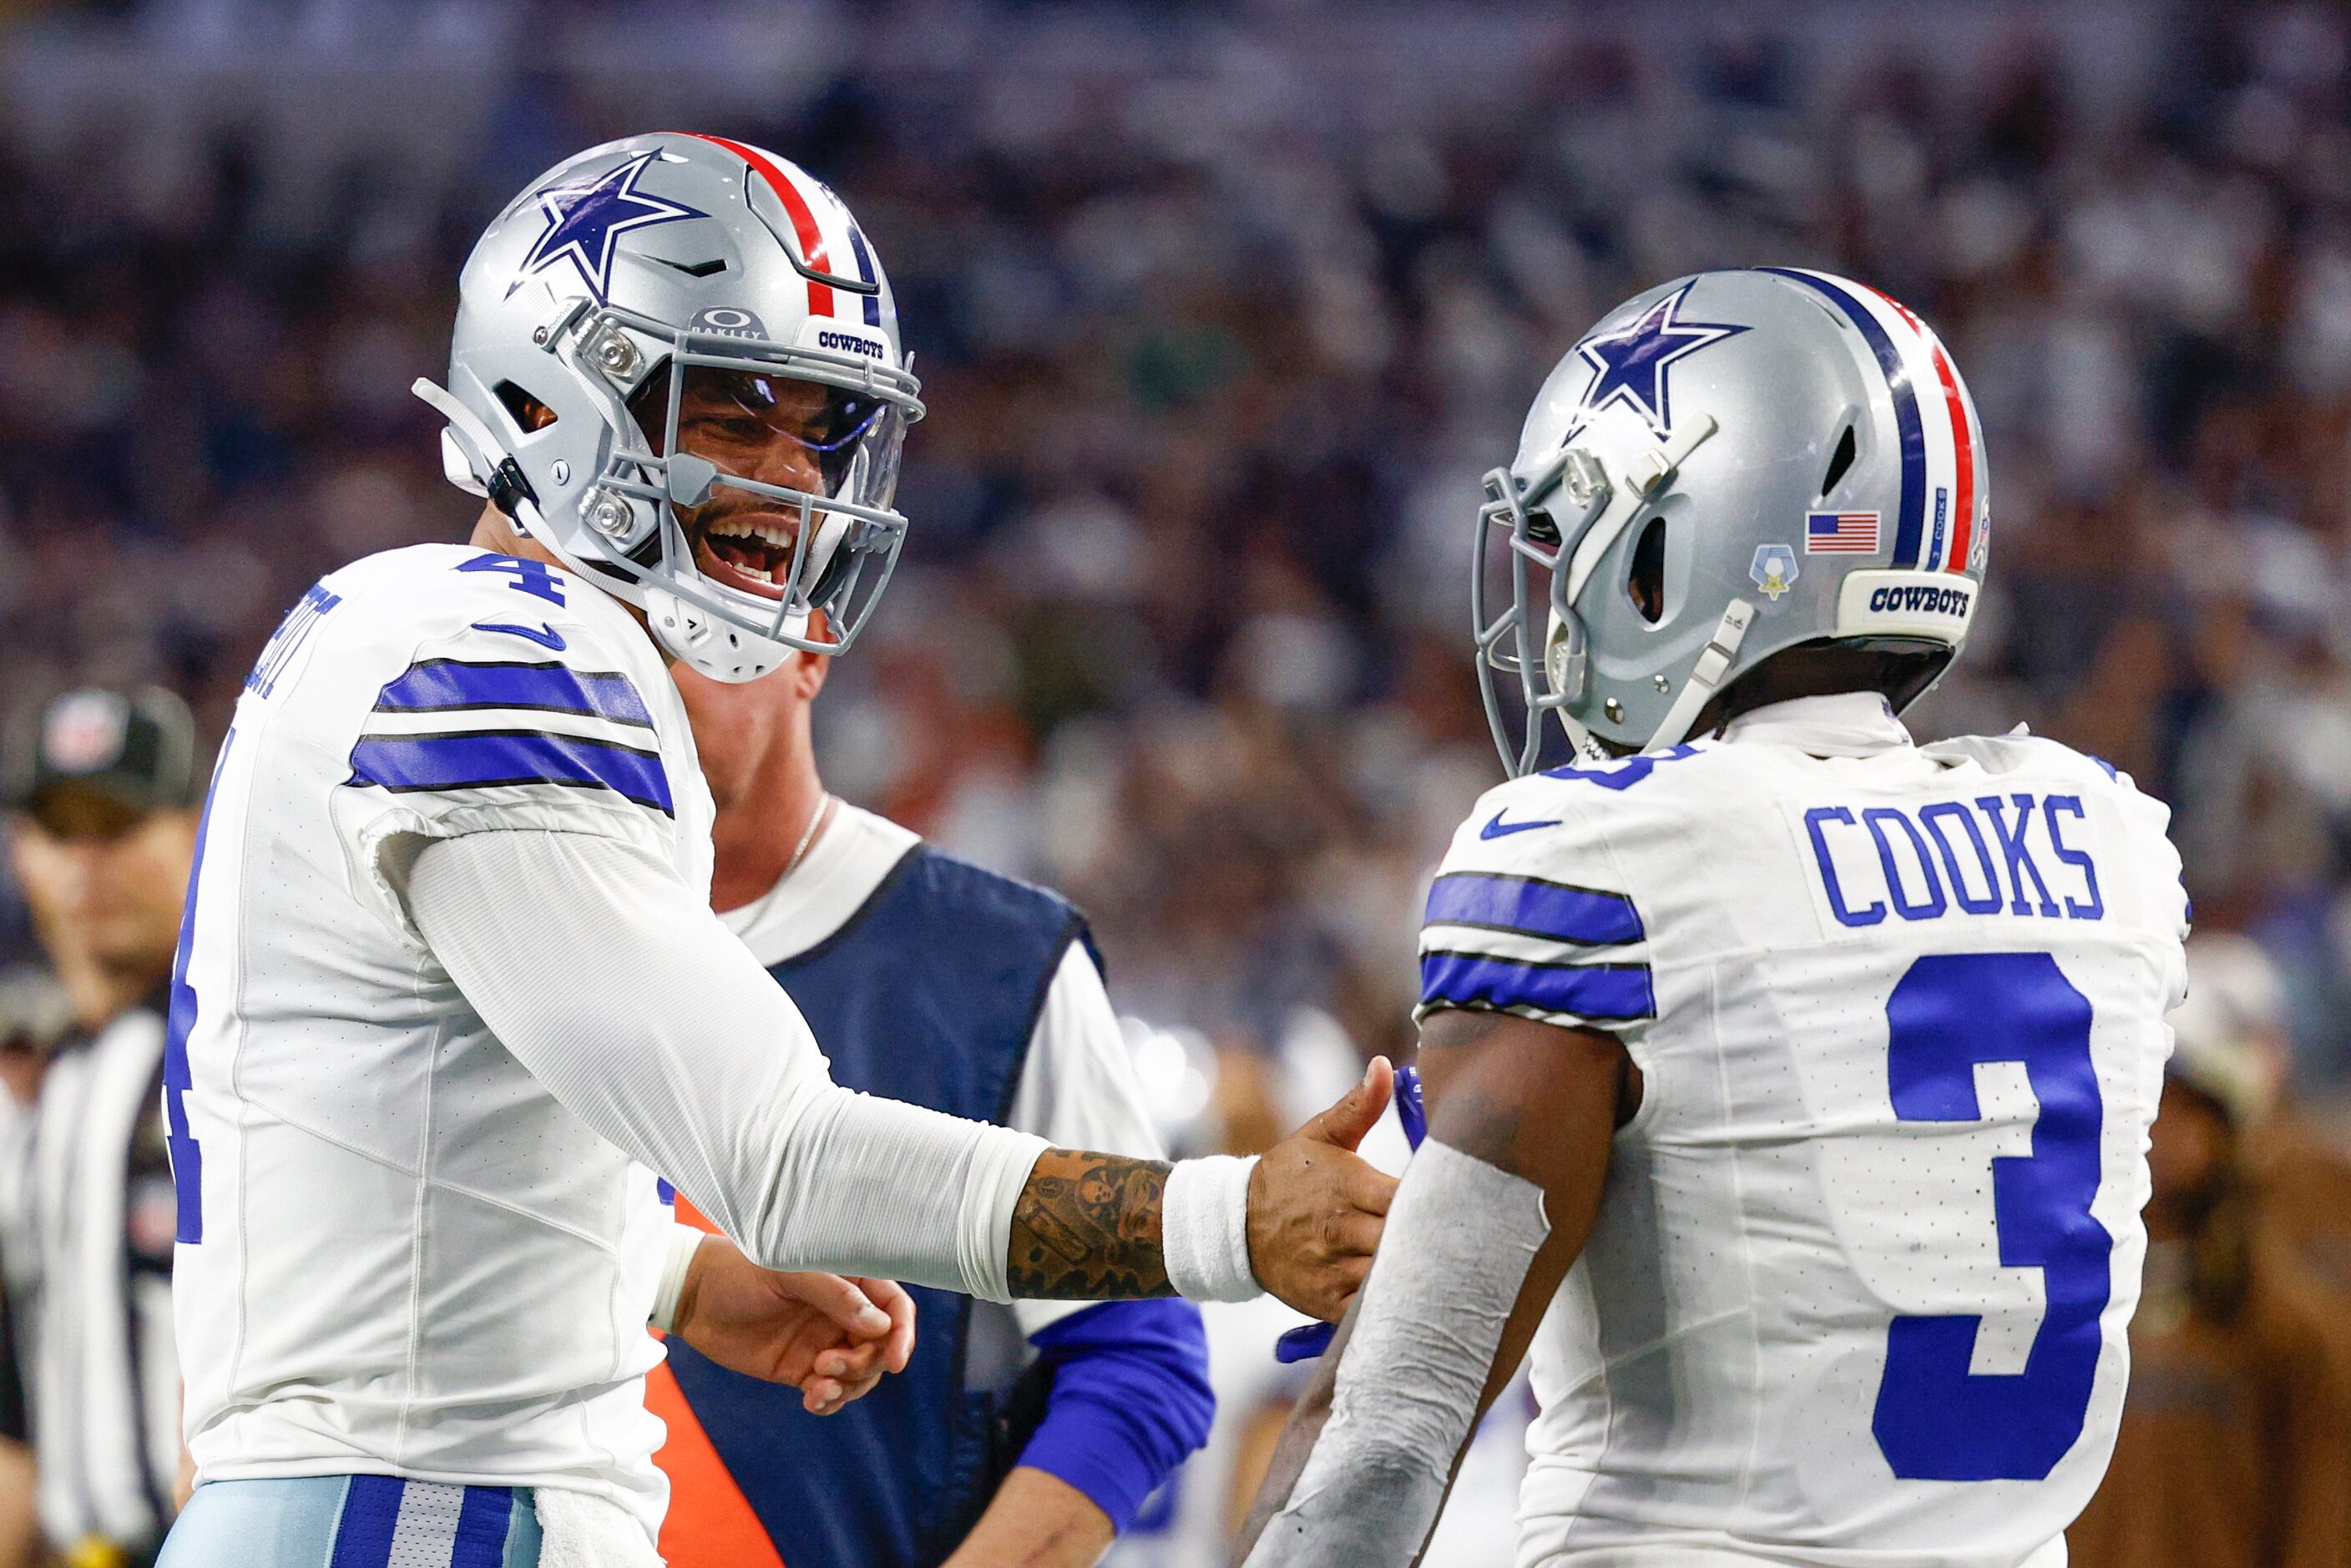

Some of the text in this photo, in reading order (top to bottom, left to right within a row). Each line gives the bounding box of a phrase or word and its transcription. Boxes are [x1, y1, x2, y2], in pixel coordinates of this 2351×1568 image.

[818, 331, 883, 360] COWBOYS
[453, 553, 566, 609] 4
[1869, 587, 1969, 618] COWBOYS
[1804, 793, 2104, 927] COOKS
[1873, 952, 2113, 1481] 3
